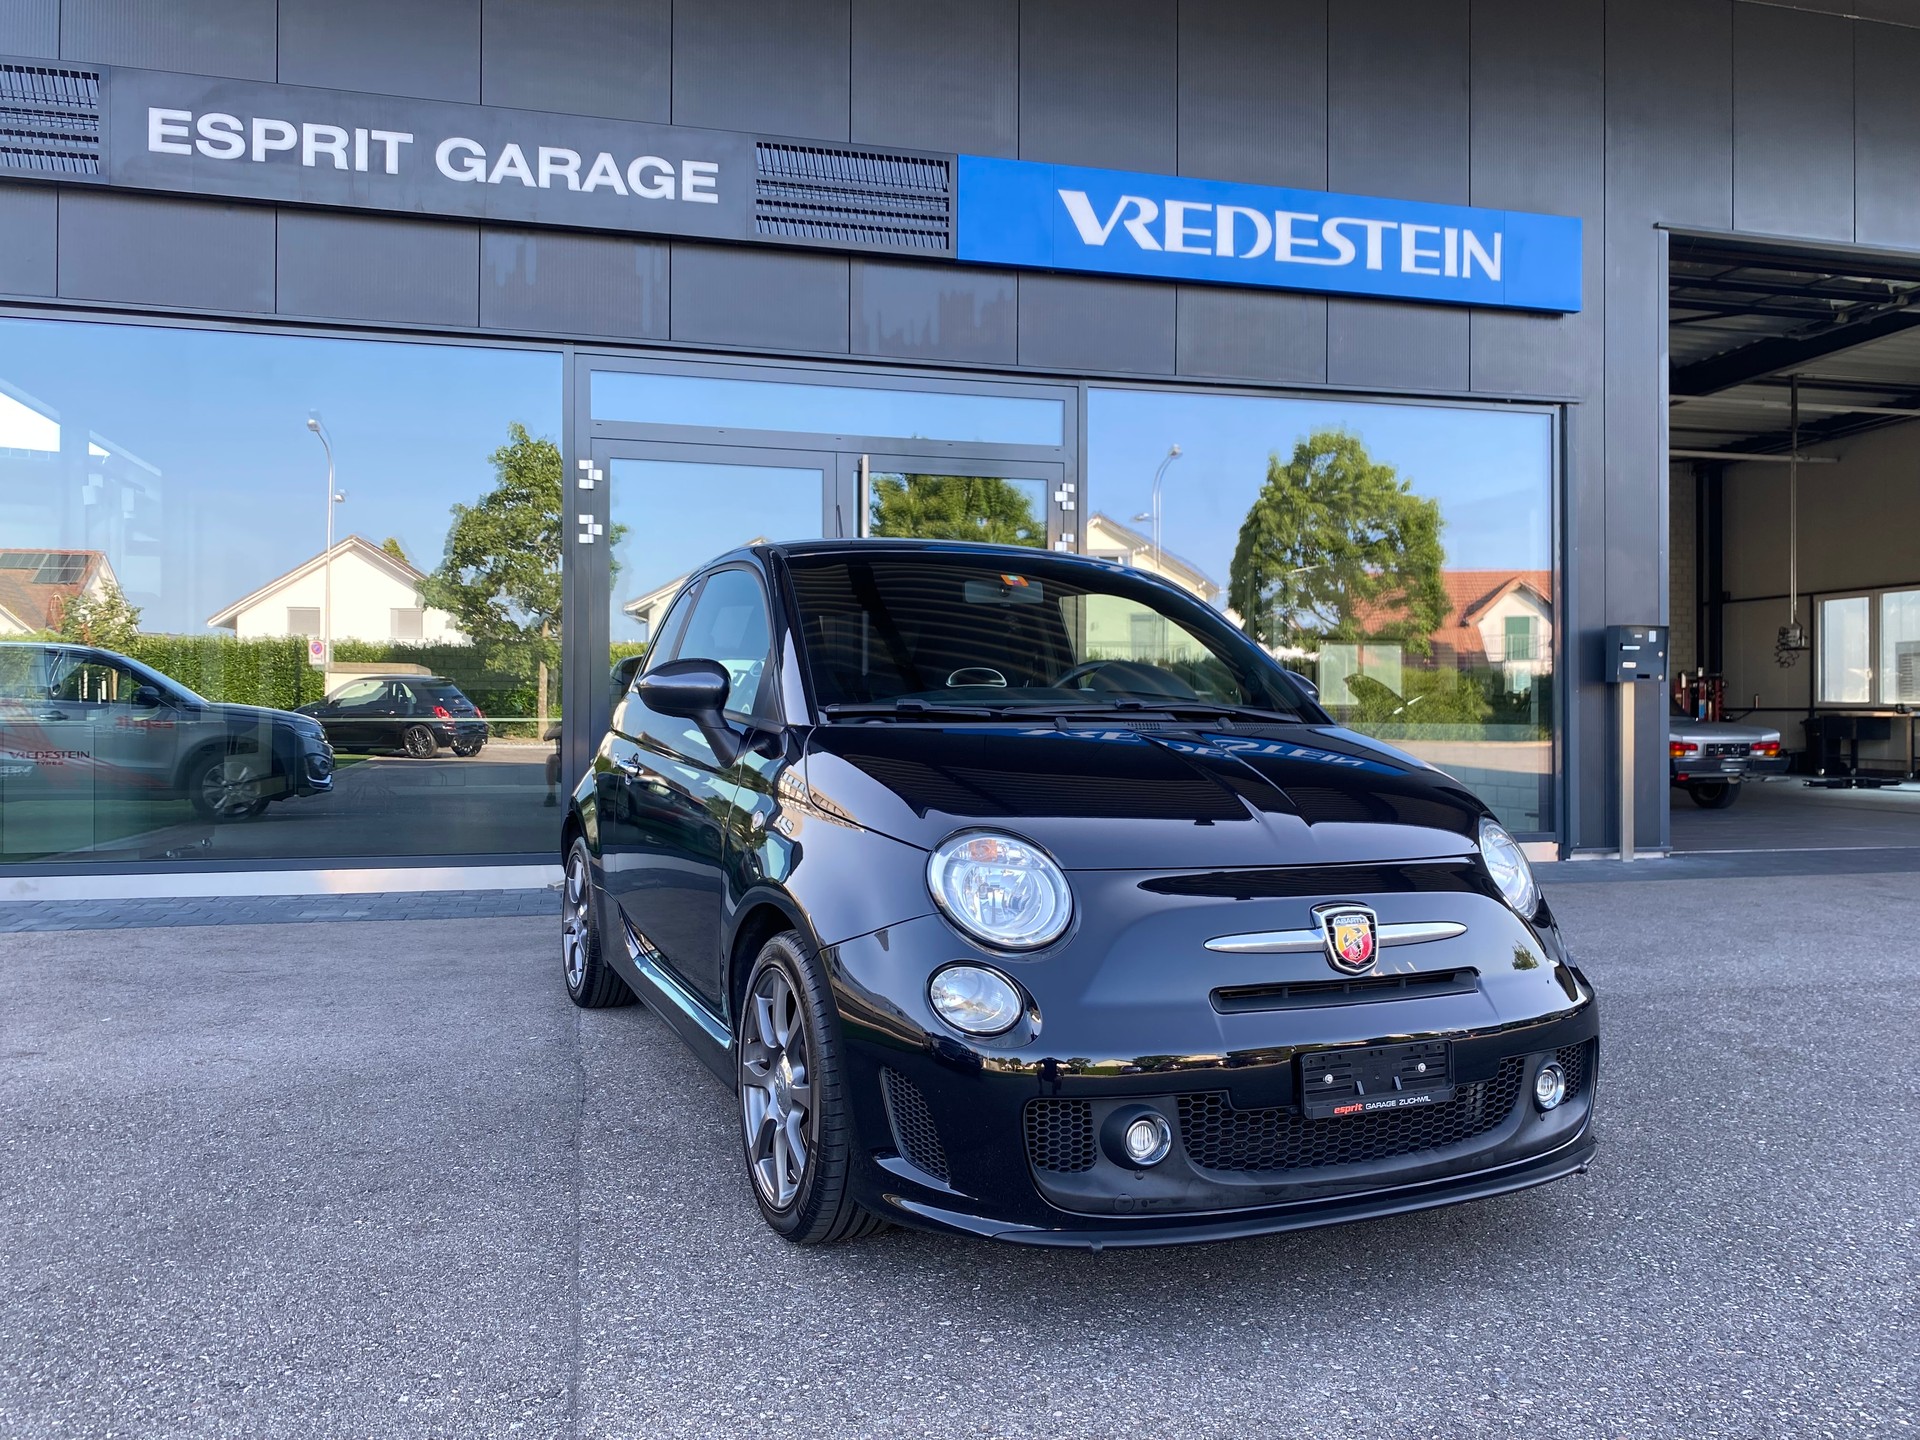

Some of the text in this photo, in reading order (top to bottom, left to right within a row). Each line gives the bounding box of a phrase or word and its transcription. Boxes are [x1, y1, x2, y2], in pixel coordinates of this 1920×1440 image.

[147, 106, 719, 205] ESPRIT GARAGE
[1057, 189, 1503, 282] VREDESTEIN
[9, 750, 90, 760] VREDESTEIN
[1336, 916, 1366, 925] ABARTH
[1334, 1096, 1431, 1114] esprit GARAGE ZUCHWIL
